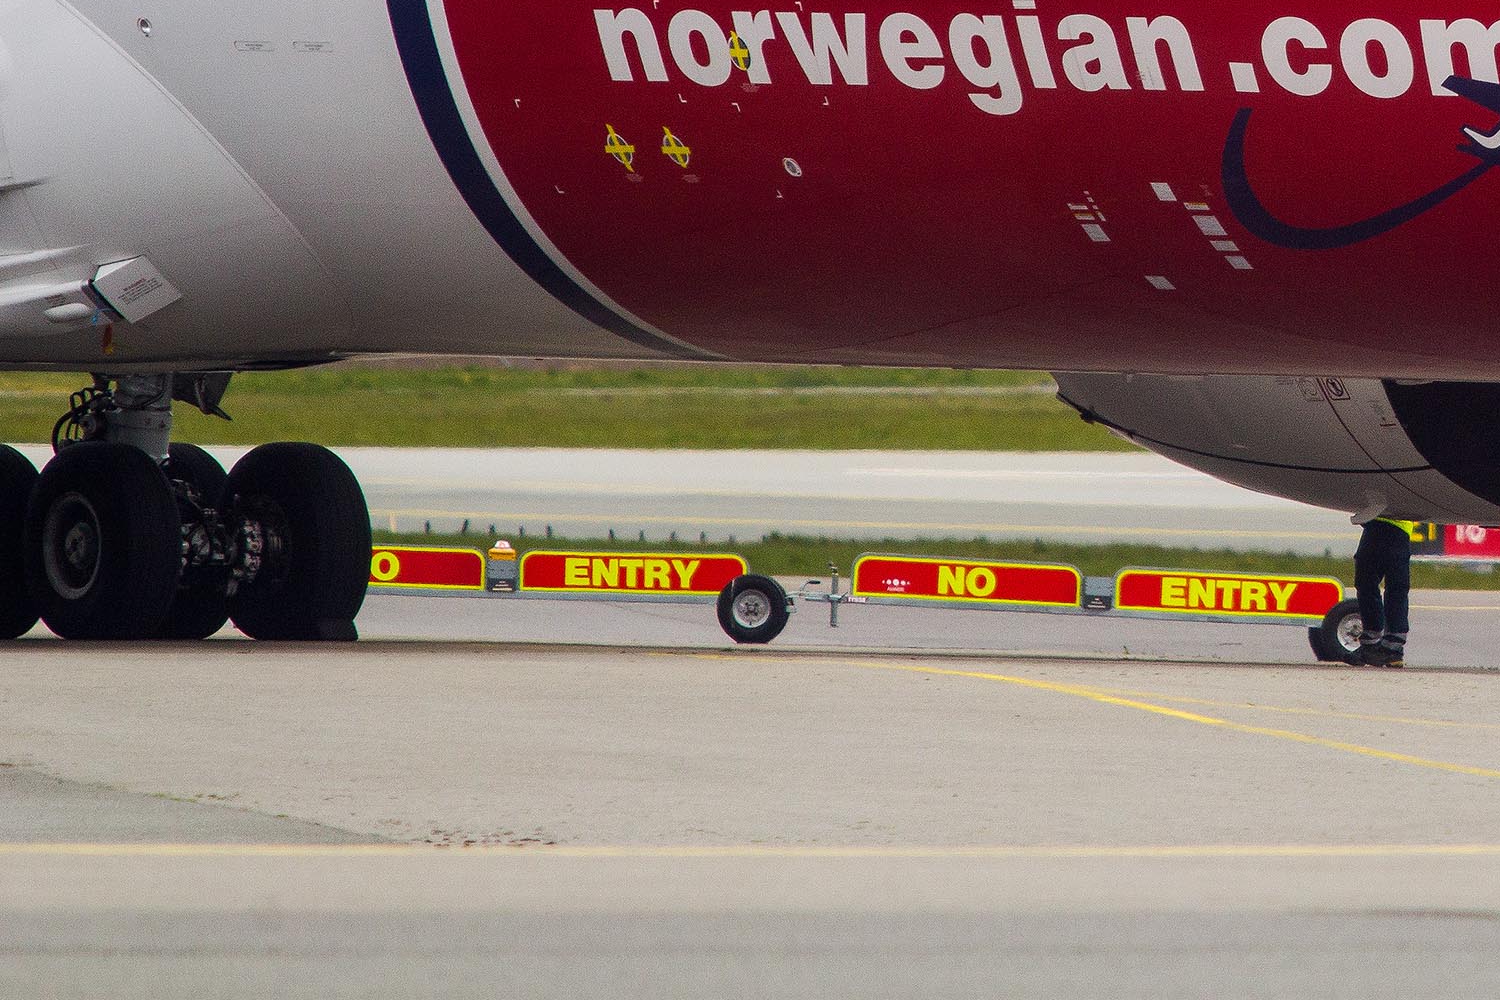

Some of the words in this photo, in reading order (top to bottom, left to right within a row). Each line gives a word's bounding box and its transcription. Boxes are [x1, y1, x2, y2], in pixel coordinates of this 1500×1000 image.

[565, 558, 699, 588] ENTRY
[938, 565, 997, 597] NO
[1161, 577, 1297, 610] ENTRY
